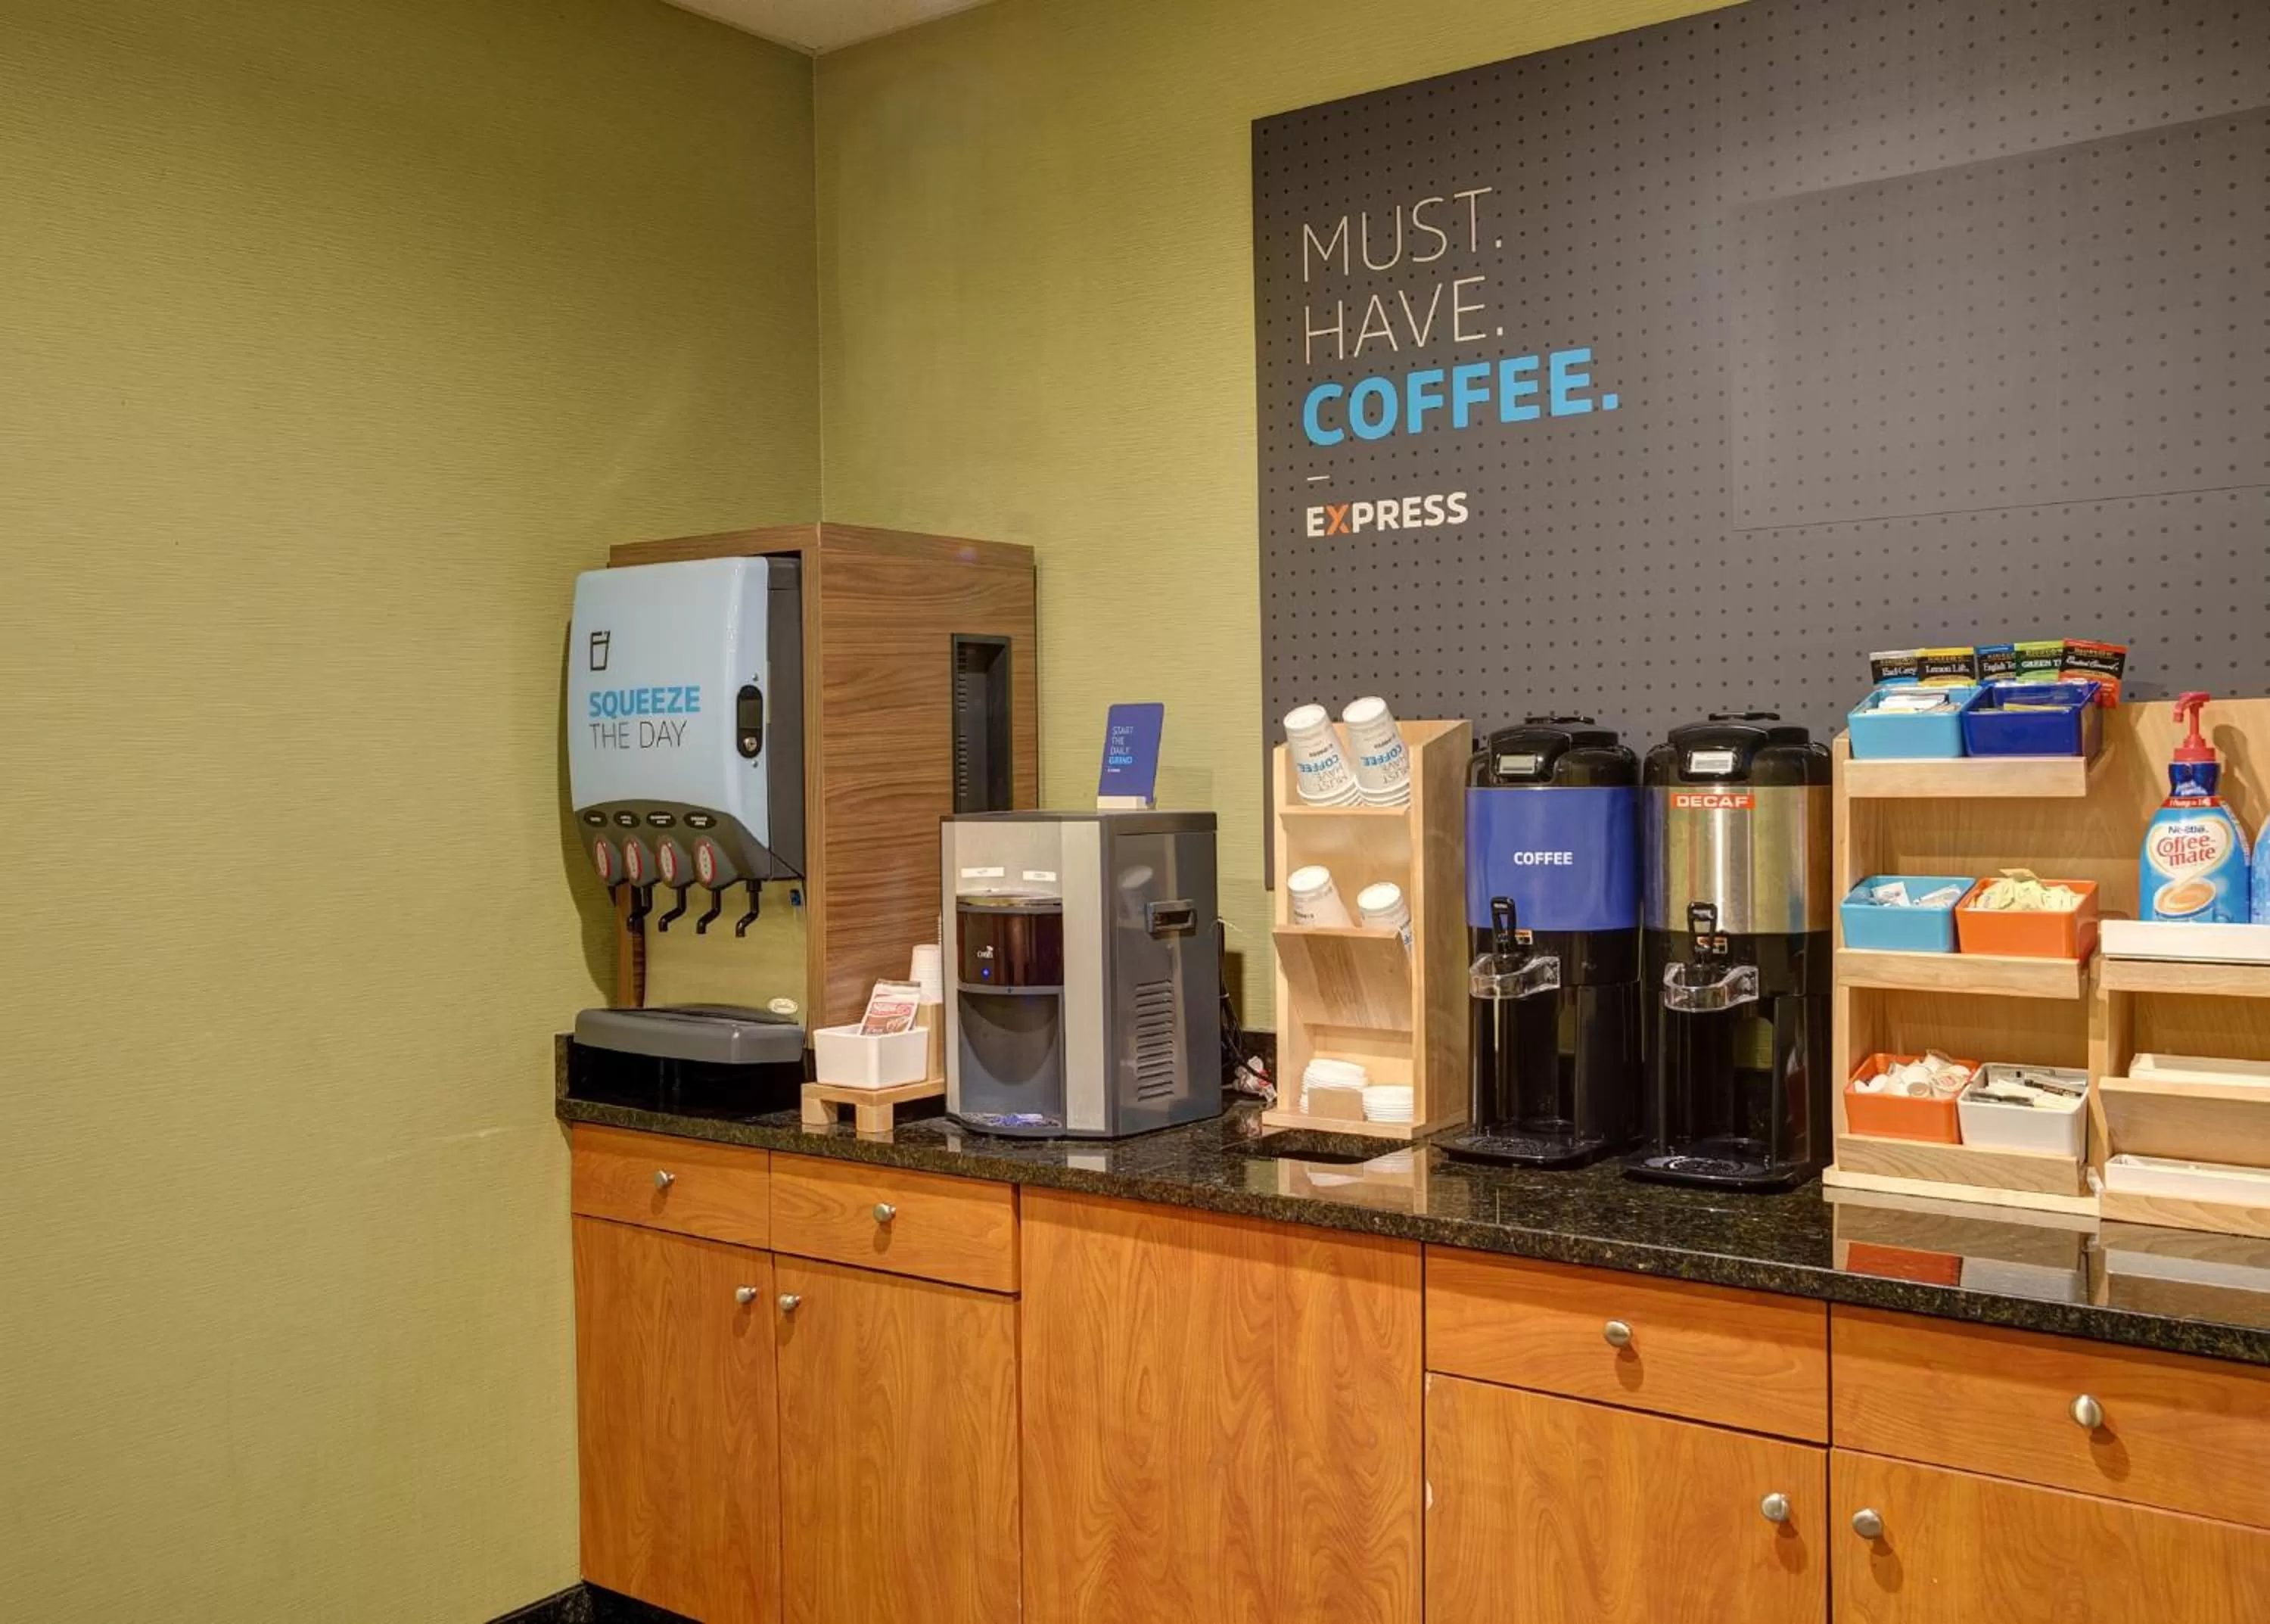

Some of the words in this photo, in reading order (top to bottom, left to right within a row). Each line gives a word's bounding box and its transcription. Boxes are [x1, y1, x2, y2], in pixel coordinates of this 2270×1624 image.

[1303, 187, 1502, 282] MUST.
[1305, 275, 1503, 365] HAVE.
[1303, 347, 1619, 446] COFFEE.
[1307, 491, 1469, 537] EXPRESS
[2021, 660, 2052, 668] GREEN
[589, 685, 701, 719] SQUEEZE
[589, 722, 630, 750] THE
[639, 720, 687, 748] DAY
[1676, 795, 1748, 807] DECAF
[1513, 851, 1574, 865] COFFEE
[2169, 848, 2216, 866] mate
